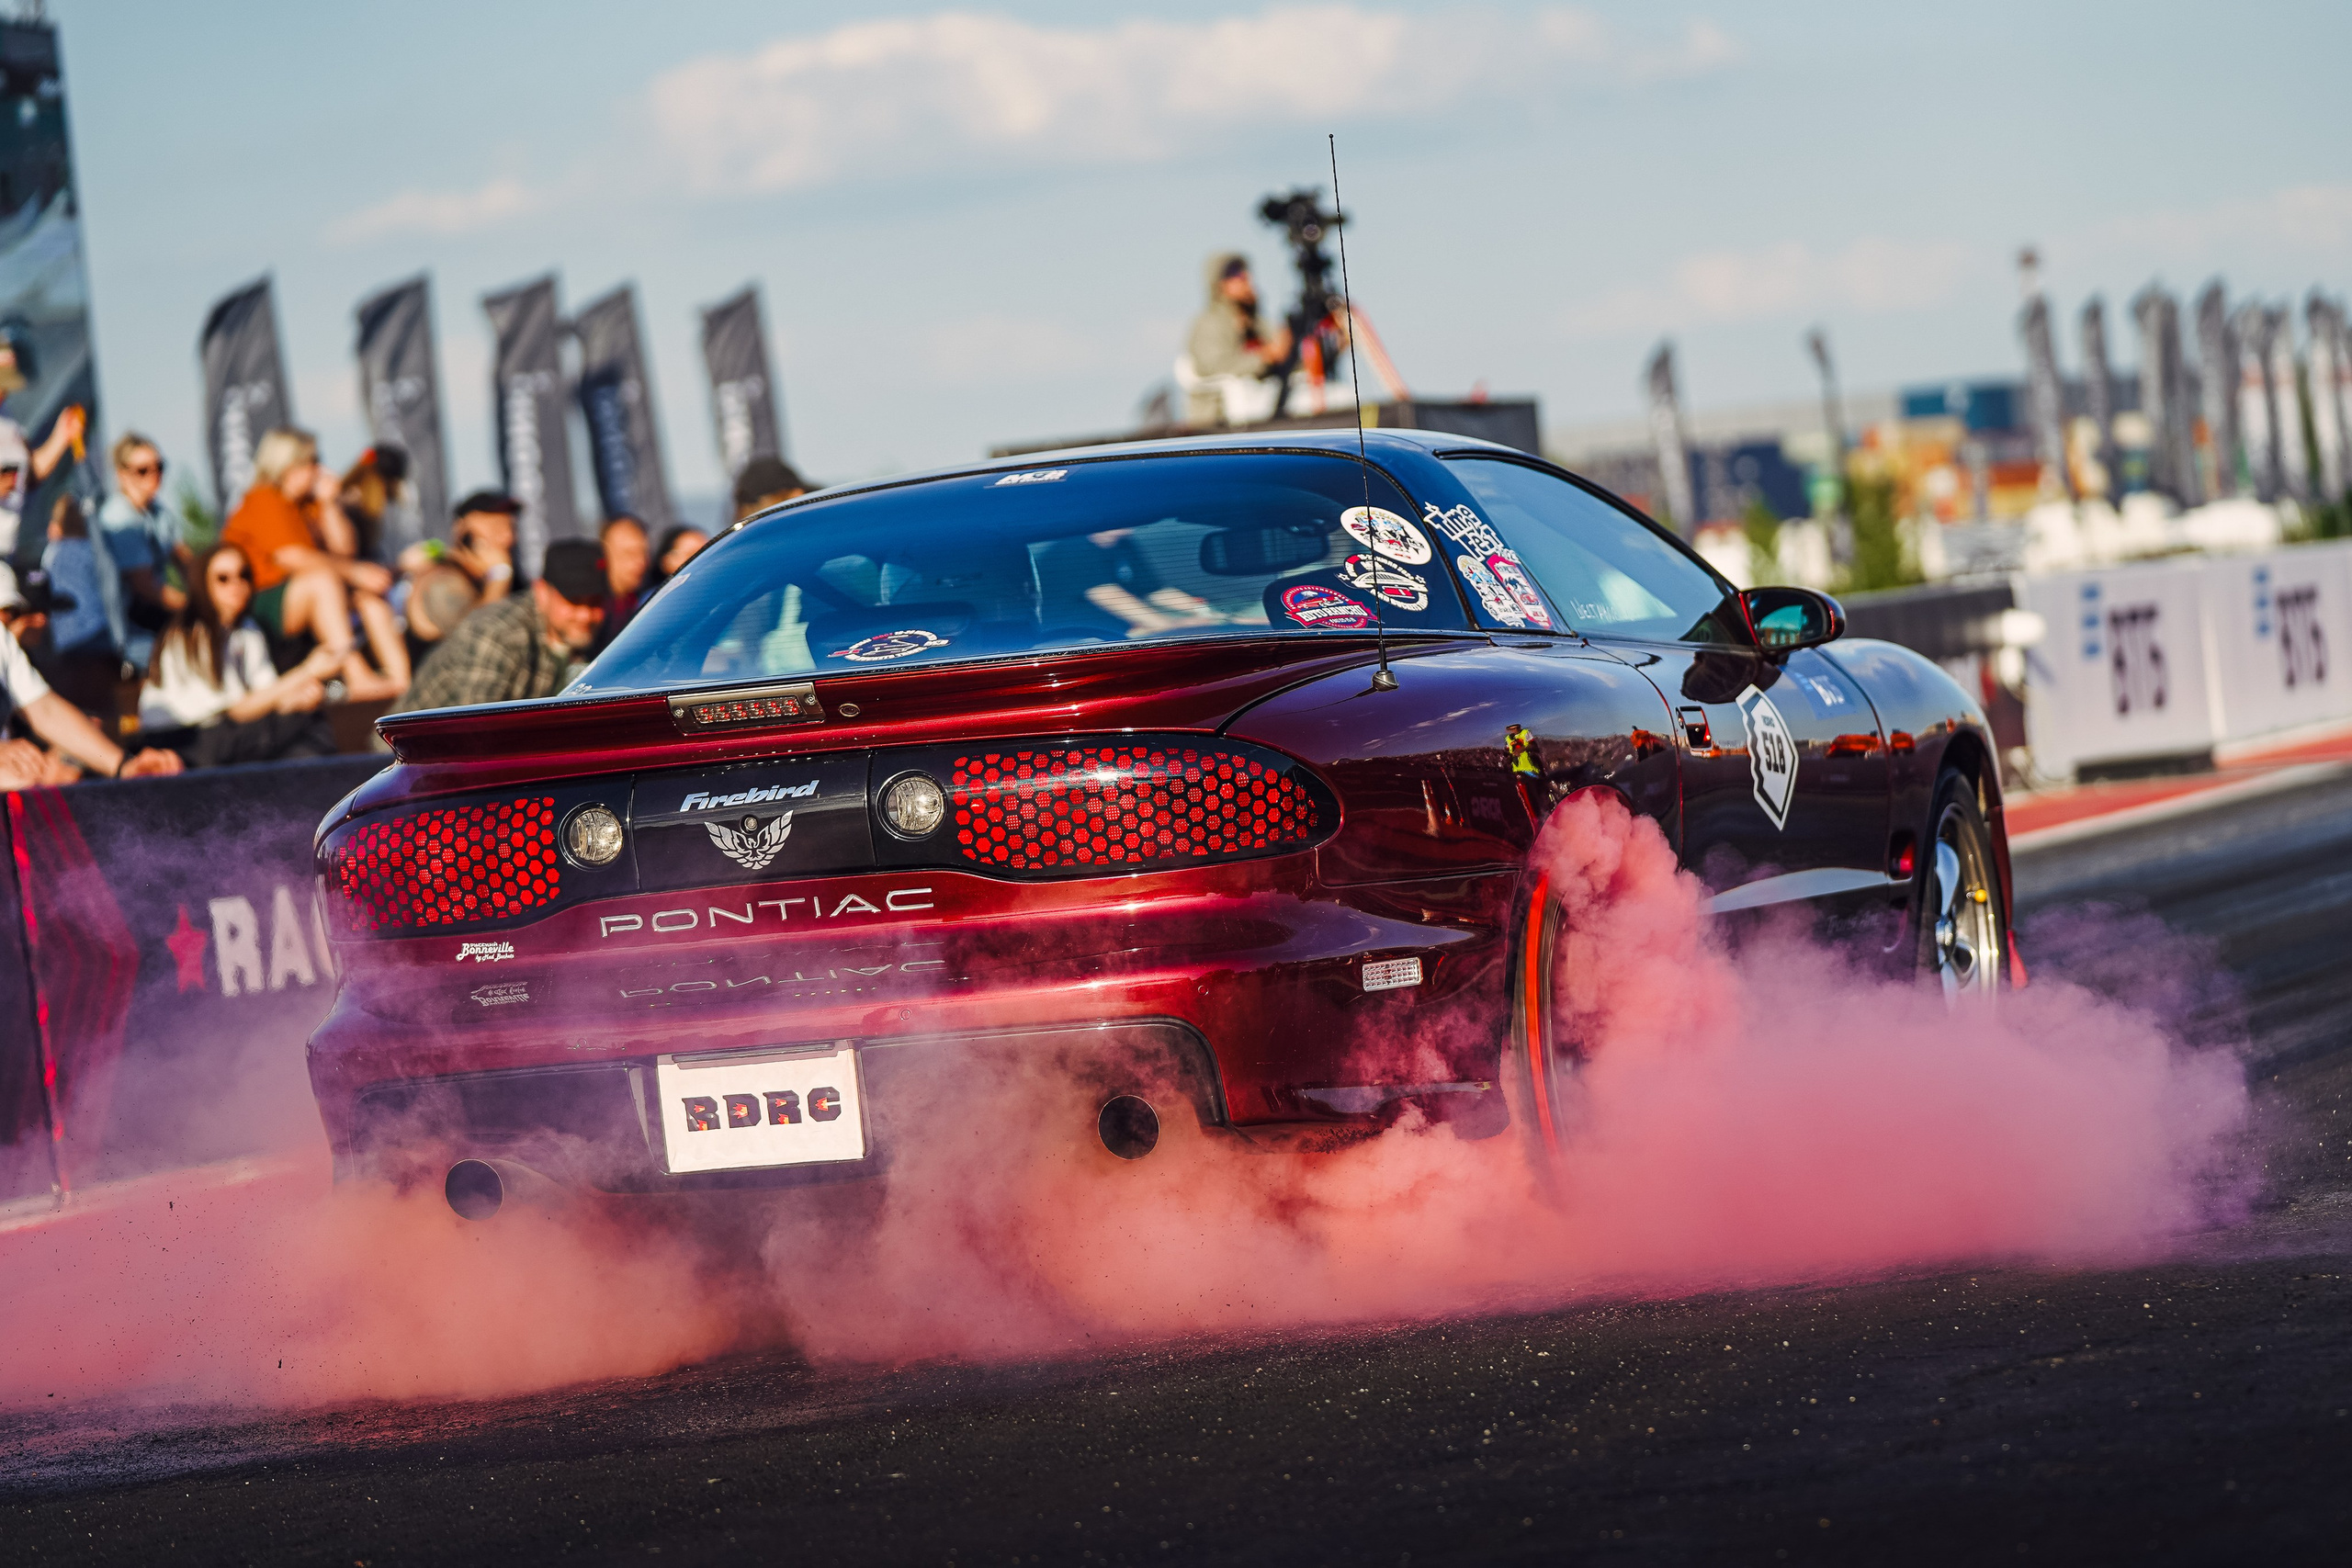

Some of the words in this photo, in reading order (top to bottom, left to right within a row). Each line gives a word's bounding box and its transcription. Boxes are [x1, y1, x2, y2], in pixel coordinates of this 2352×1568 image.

[1295, 607, 1329, 623] AUTO
[1323, 604, 1369, 617] RANCHO
[1760, 730, 1786, 775] 518
[679, 779, 820, 813] Firebird
[599, 887, 934, 938] PONTIAC
[456, 941, 514, 962] Bonneville
[681, 1086, 842, 1133] RDRC
